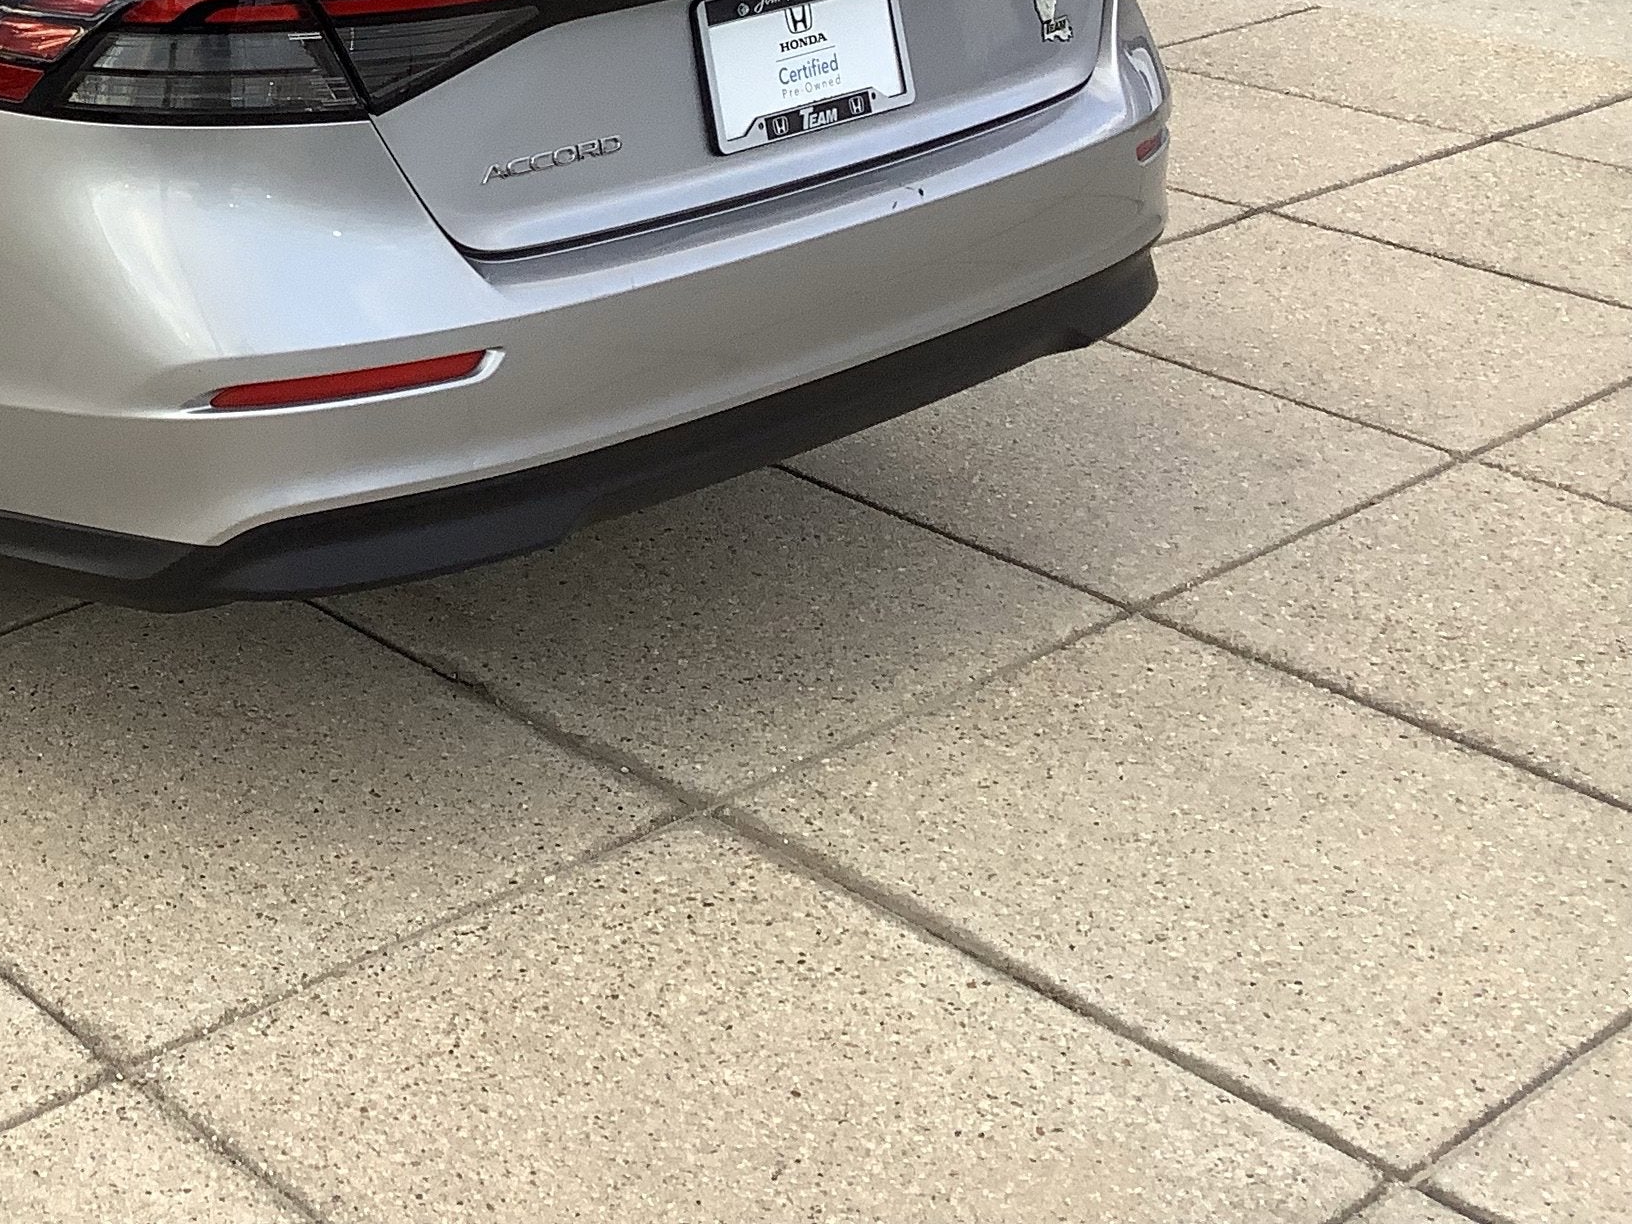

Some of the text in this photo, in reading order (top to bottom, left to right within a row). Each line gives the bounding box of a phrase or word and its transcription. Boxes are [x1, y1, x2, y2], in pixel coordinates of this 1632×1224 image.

[779, 32, 827, 52] HONDA
[778, 53, 839, 85] Certified
[782, 75, 842, 99] Pre-Owned
[799, 107, 838, 130] TEAM
[481, 134, 623, 185] ACCORD
